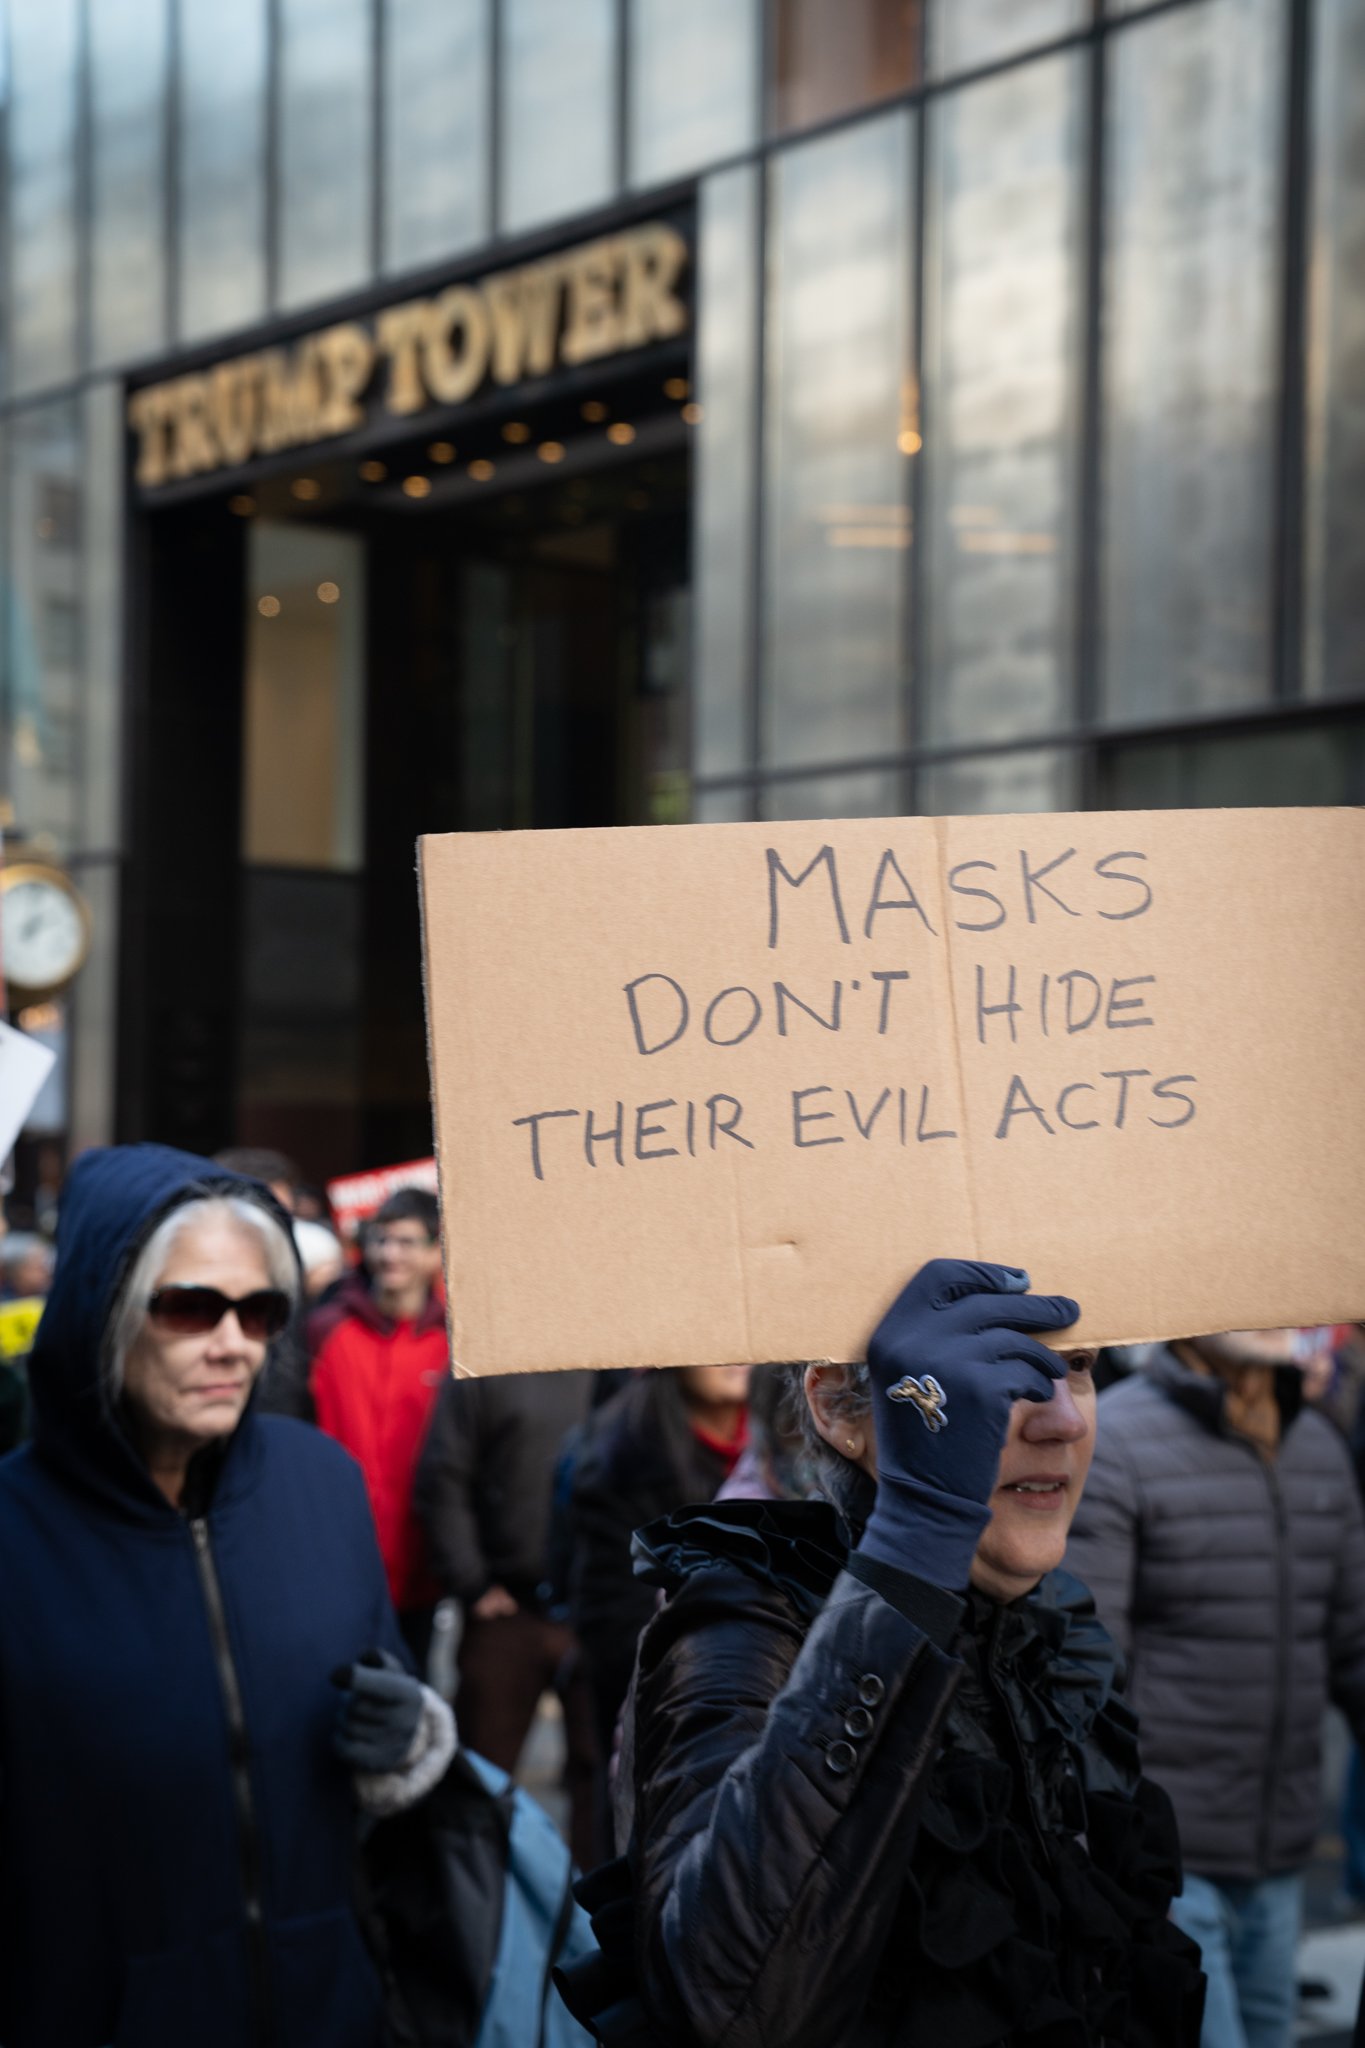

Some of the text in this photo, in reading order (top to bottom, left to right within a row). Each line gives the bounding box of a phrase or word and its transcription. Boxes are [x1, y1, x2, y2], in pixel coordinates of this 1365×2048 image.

[131, 223, 687, 486] TRUMP TOWER
[766, 844, 1153, 949] MASKS
[622, 964, 1156, 1055] DON'T HIDE
[512, 1069, 1197, 1180] THEIR EVIL ACTS
